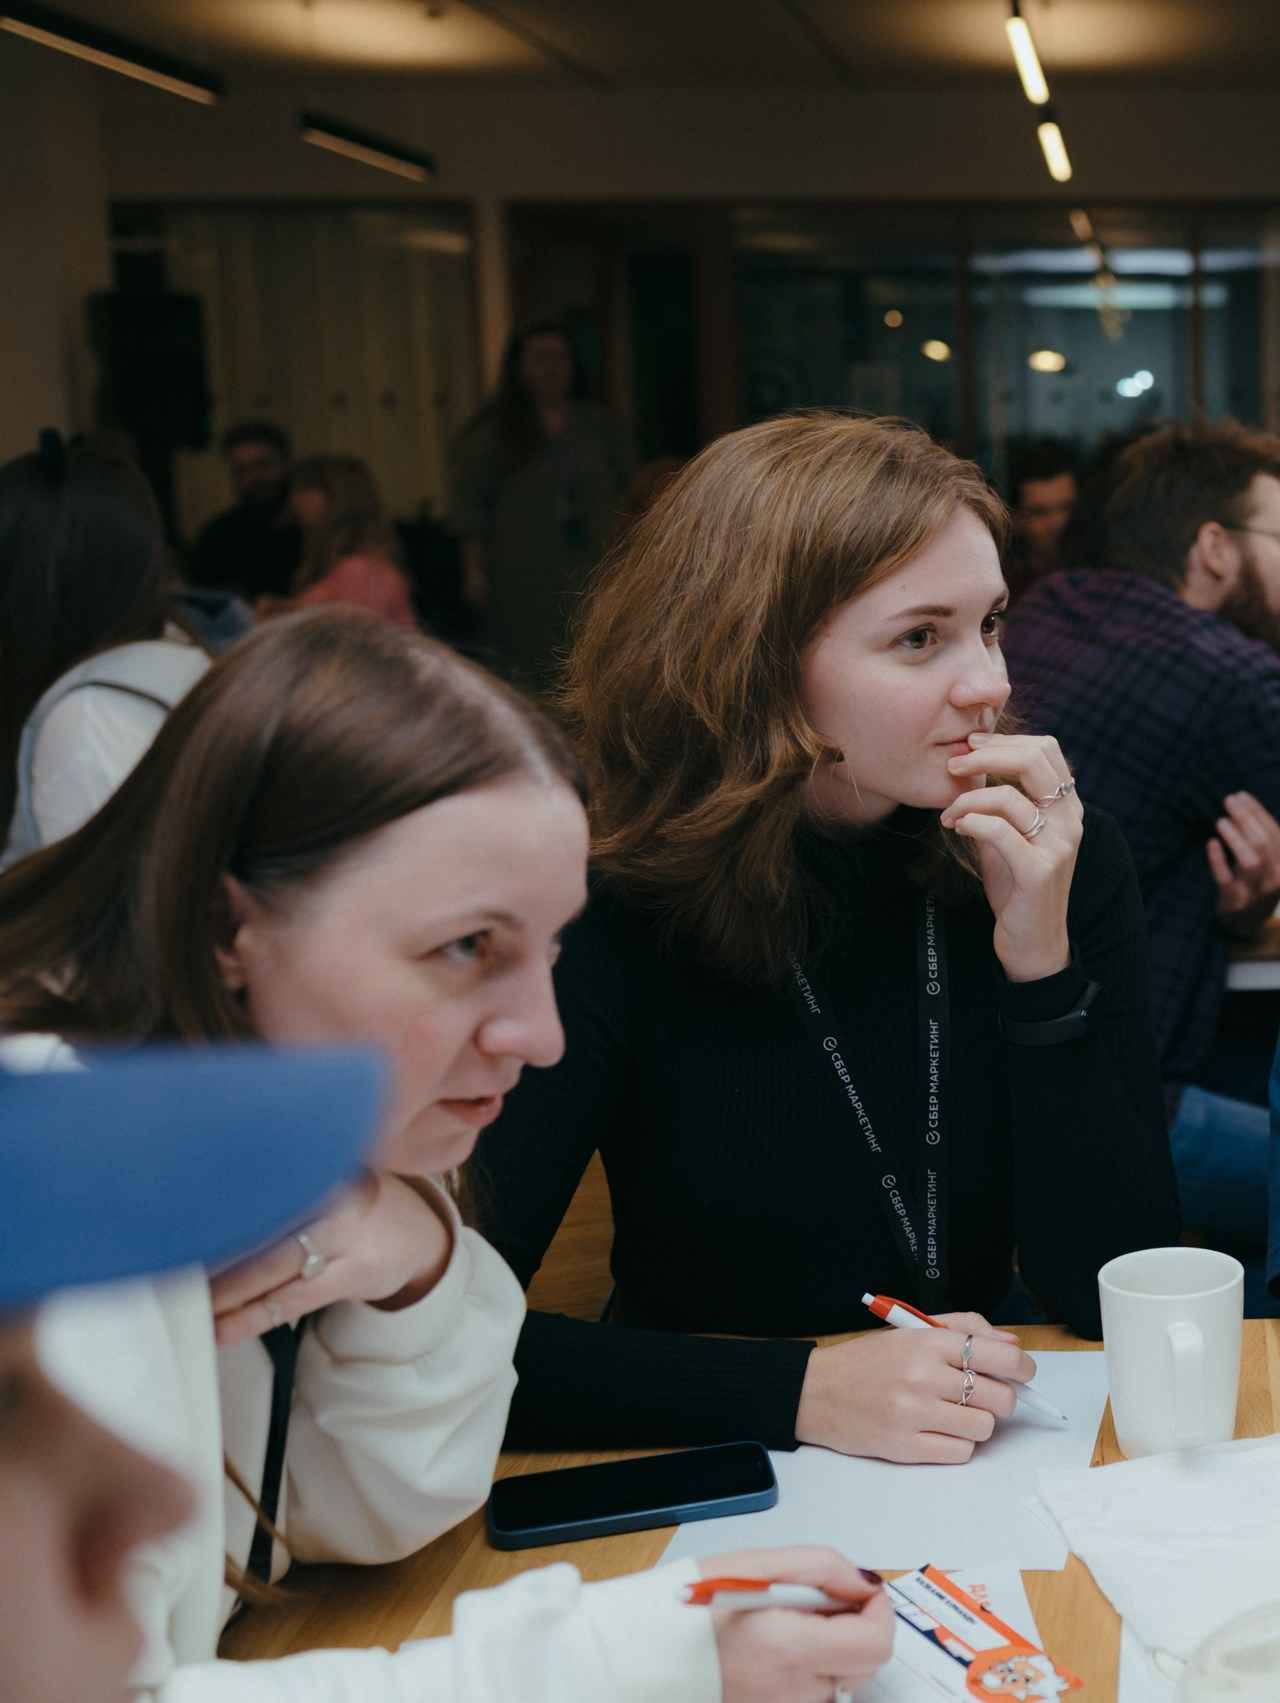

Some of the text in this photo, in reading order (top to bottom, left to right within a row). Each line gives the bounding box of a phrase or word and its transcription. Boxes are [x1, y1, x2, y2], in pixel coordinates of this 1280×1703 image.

[927, 947, 938, 979] СБЕР
[831, 1052, 882, 1153] СБЕР МАРКЕТИНГ
[928, 1018, 939, 1128] СБЕР МАРКЕТИНГ
[889, 1189, 919, 1260] СБЕР МАРКЕ
[927, 1168, 937, 1266] СБЕР МАРКЕТИНГ
